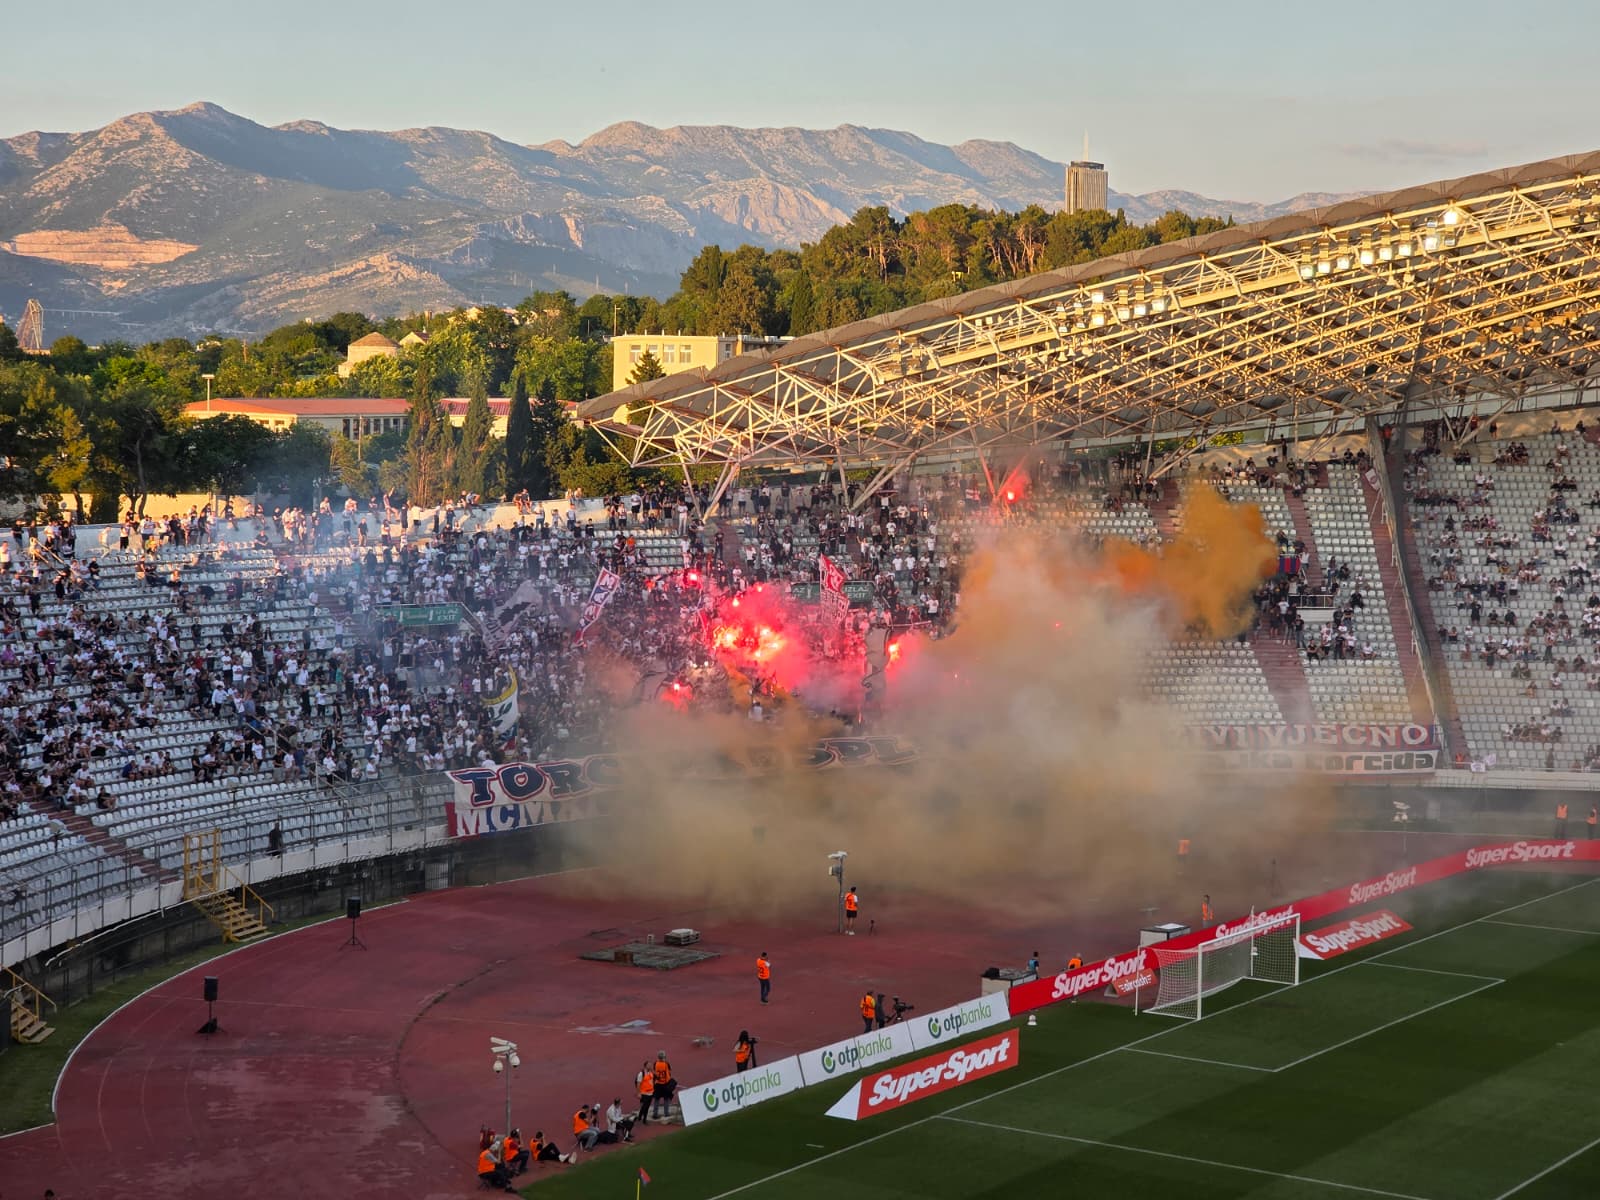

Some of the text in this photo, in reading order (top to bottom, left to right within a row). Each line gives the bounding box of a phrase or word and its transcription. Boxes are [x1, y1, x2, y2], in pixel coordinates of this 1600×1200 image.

[1465, 841, 1576, 868] SuperSport
[1349, 866, 1417, 904] SuperSport
[1305, 912, 1402, 953] SuperSport
[1051, 949, 1147, 998] SuperSport
[868, 1037, 1011, 1107] SuperSport
